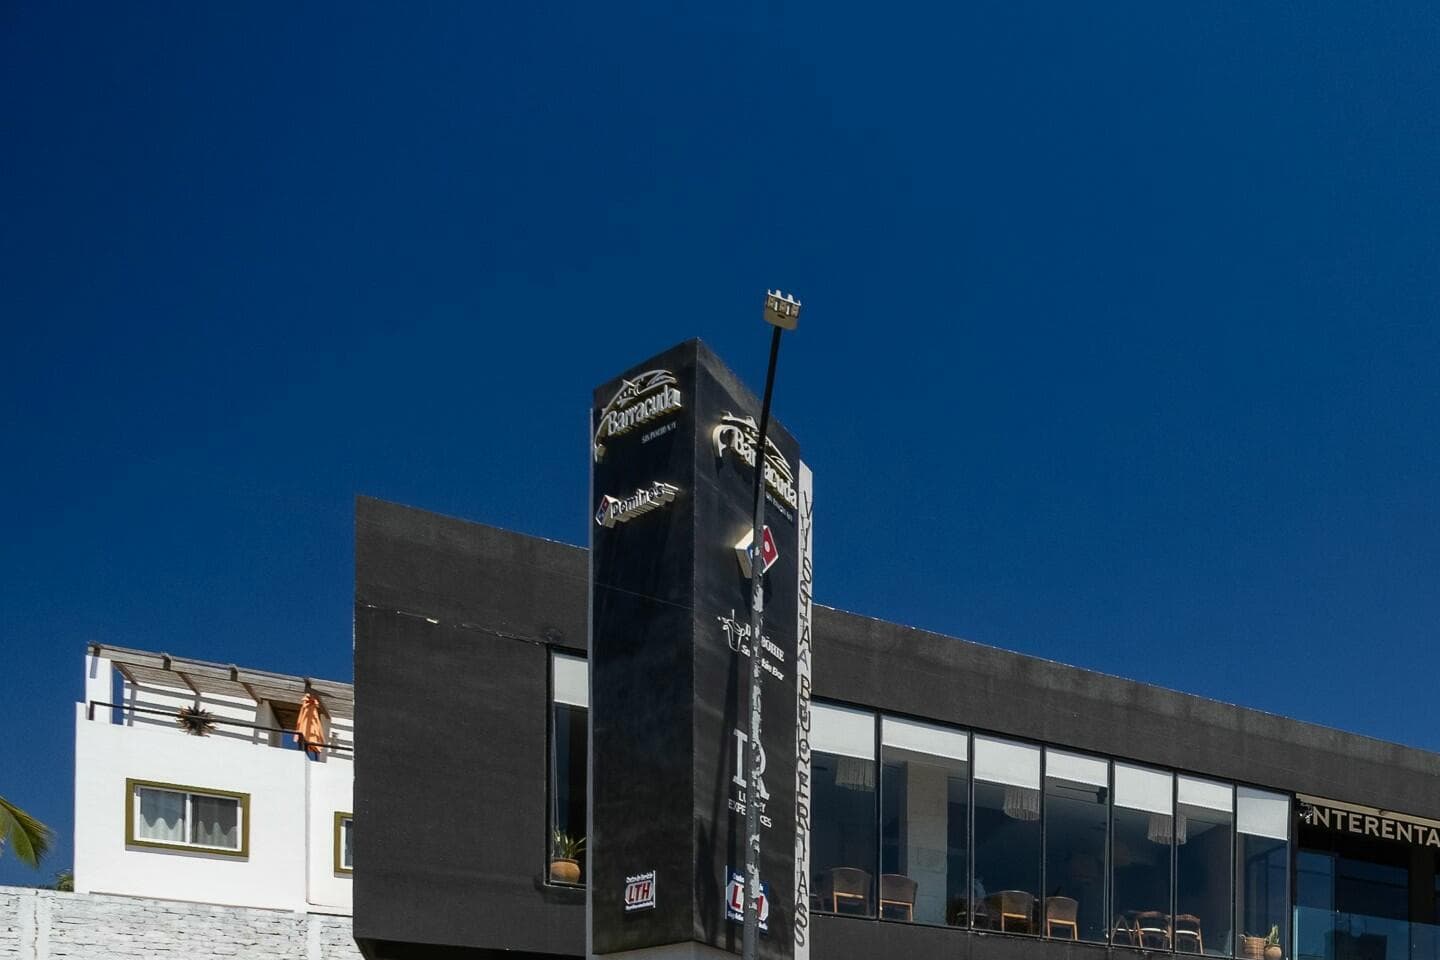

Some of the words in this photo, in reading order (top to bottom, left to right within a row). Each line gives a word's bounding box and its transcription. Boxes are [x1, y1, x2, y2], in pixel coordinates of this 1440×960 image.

[607, 384, 681, 437] Barracuda
[734, 430, 798, 510] Baracuda
[629, 882, 651, 902] LTH
